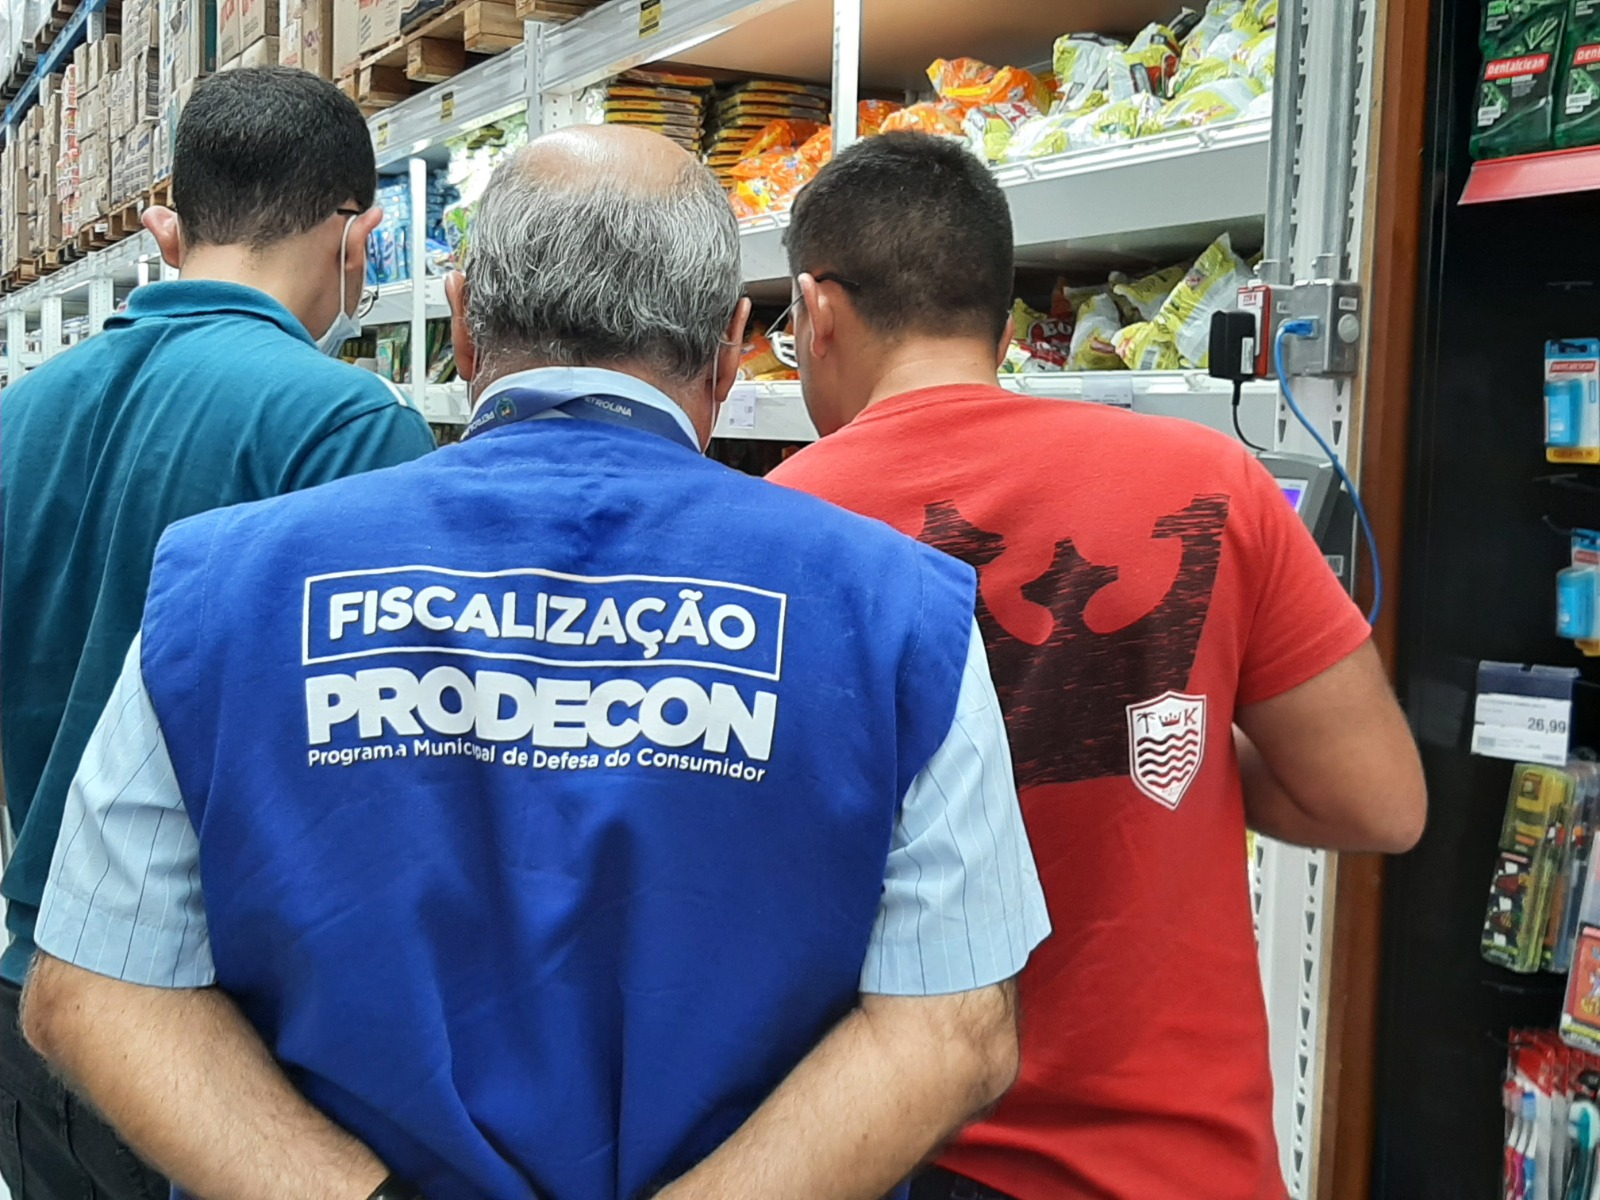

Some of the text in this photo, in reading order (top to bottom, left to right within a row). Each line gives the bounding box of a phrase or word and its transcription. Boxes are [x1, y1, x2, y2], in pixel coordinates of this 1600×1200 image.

[329, 585, 756, 659] FISCALIZAÇÃO
[305, 666, 778, 761] PRODECON
[1527, 717, 1567, 735] 26,99
[308, 737, 767, 782] Programa Municipal de Defesa do Consumidor
